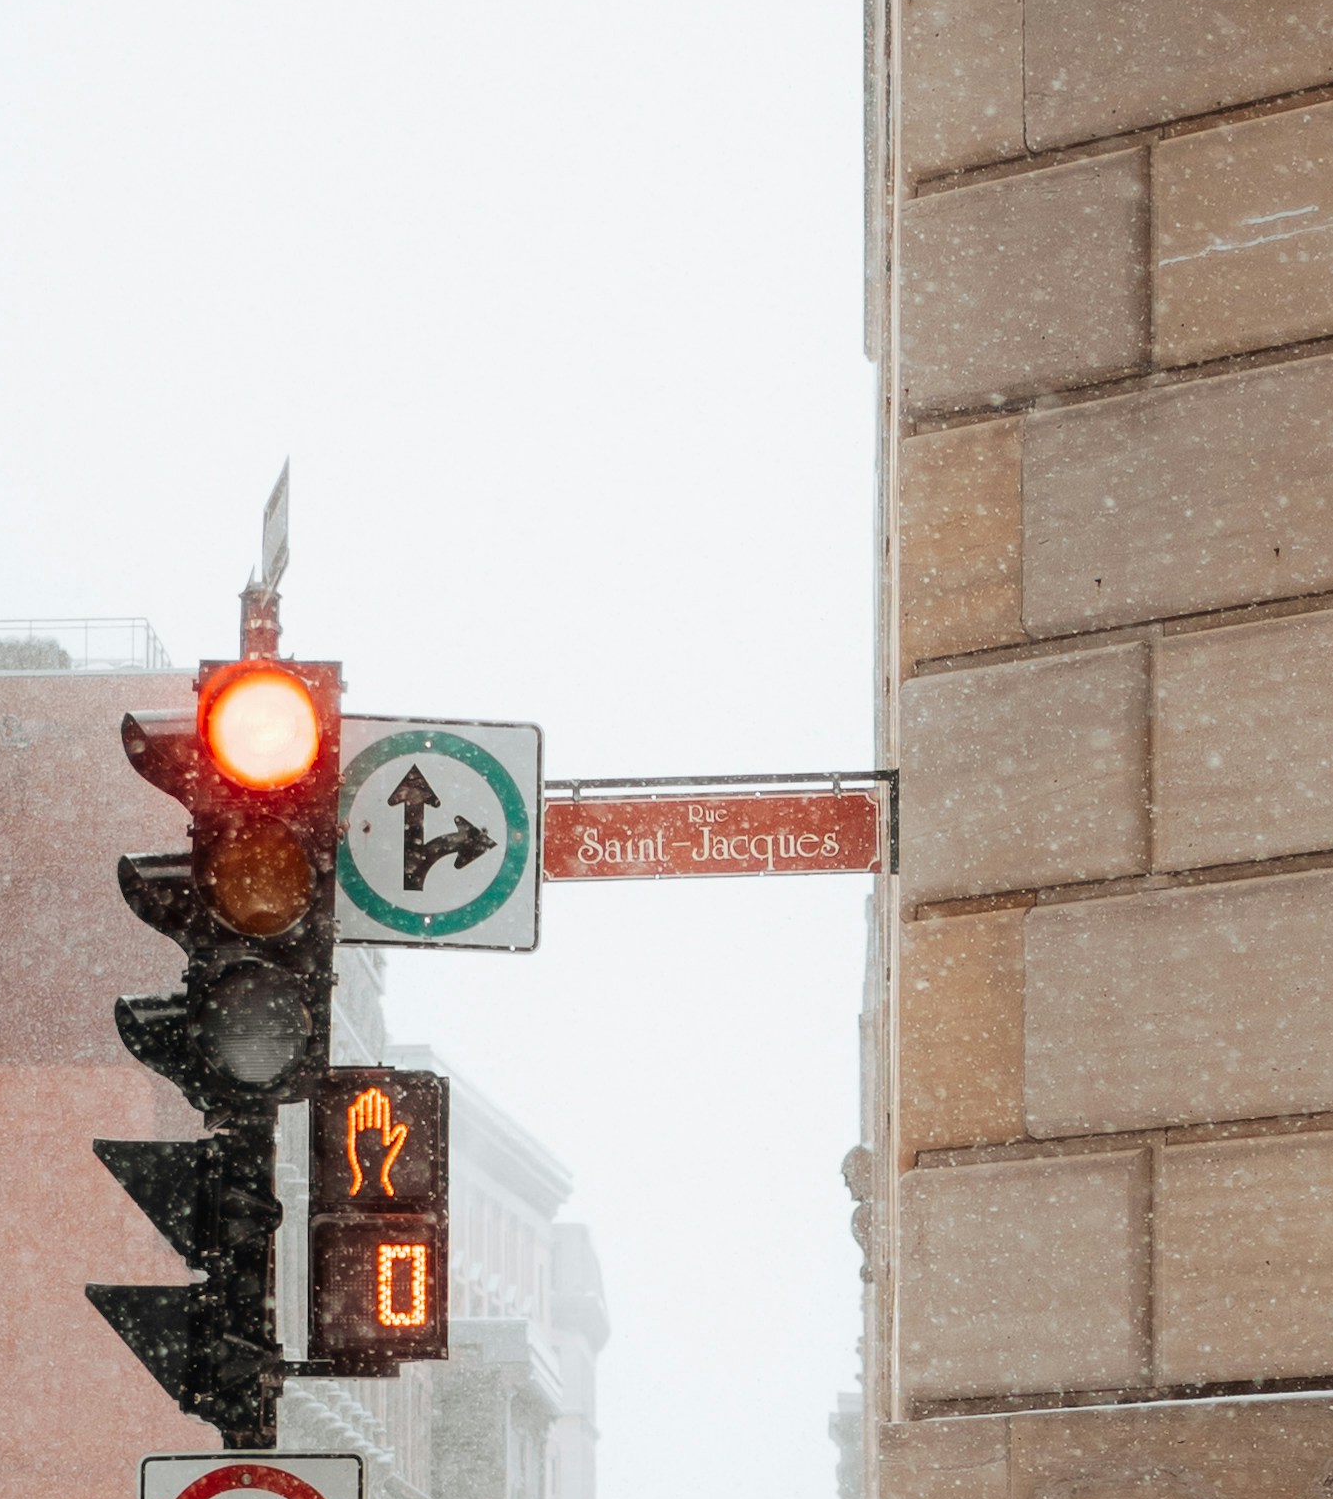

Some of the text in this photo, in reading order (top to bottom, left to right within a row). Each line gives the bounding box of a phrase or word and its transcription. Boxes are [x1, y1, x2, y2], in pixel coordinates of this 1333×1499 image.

[687, 805, 729, 823] Rue
[577, 825, 840, 871] Saint-Jacques
[378, 1244, 426, 1327] 0
